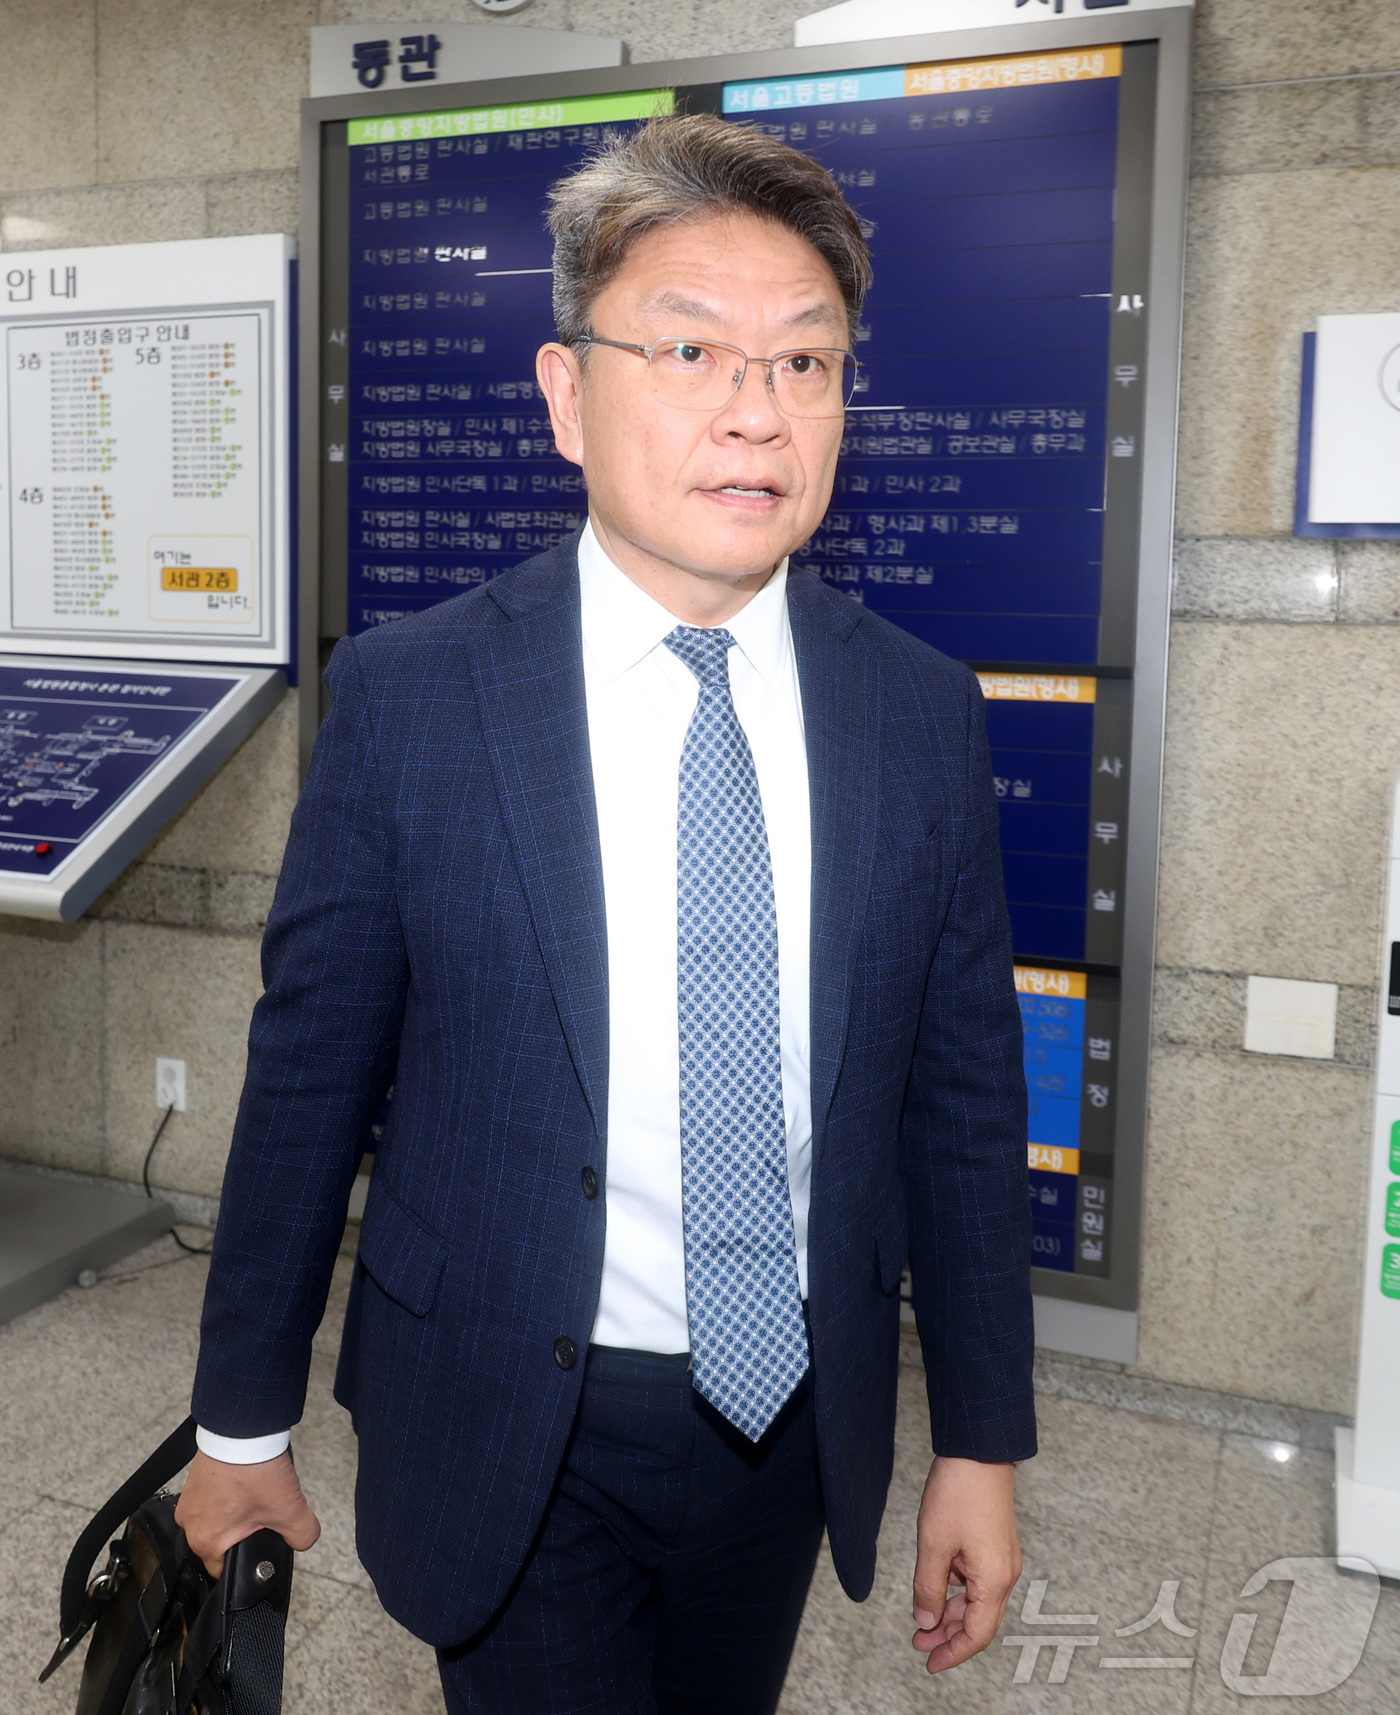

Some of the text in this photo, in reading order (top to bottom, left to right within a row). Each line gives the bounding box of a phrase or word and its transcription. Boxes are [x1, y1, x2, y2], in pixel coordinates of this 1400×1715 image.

[352, 34, 442, 88] 동관
[910, 52, 1105, 93] 서울중앙지방법원(형사)
[730, 77, 859, 110] 서울고등법원
[363, 104, 563, 140] 서울중앙지방법원(민사)
[816, 119, 877, 139] 판사실
[437, 138, 489, 158] 판사실
[507, 126, 617, 152] 재판연구원
[363, 164, 430, 184] 서관통로
[363, 196, 488, 220] 고등법원 판사실
[362, 247, 429, 266] 지방법원
[362, 290, 487, 311] 지방법원 판사실
[65, 323, 191, 347] 법정출입구 안내
[135, 346, 162, 366] 5층
[362, 337, 486, 357] 지방법원 판사실
[17, 352, 41, 371] 3층
[362, 384, 422, 402] 지방법원
[426, 383, 472, 400] 판사실
[362, 419, 451, 438] 지방법원장실
[465, 418, 497, 436] 민사
[988, 409, 1086, 429] 사무국장실
[362, 439, 421, 458] 지방법원
[426, 439, 503, 458] 사무국장실
[947, 434, 1016, 454] 공보관실
[1030, 433, 1086, 453] 총무과
[361, 475, 421, 493] 지방법원
[425, 475, 487, 493] 민사단독
[885, 475, 924, 494] 민사
[928, 475, 962, 493] 2과
[19, 486, 44, 506] 4층
[361, 511, 421, 529] 지방법원
[425, 510, 471, 528] 판사실
[484, 510, 581, 529] 사법보좌관실
[866, 513, 924, 534] 형사과
[361, 531, 421, 549] 지방법원
[425, 530, 501, 549] 민사국장실
[873, 538, 906, 556] 2과
[153, 550, 192, 566] 여기는
[168, 571, 230, 590] 서관 2층
[361, 564, 420, 583] 지방법원
[1081, 1185, 1106, 1262] 민원실
